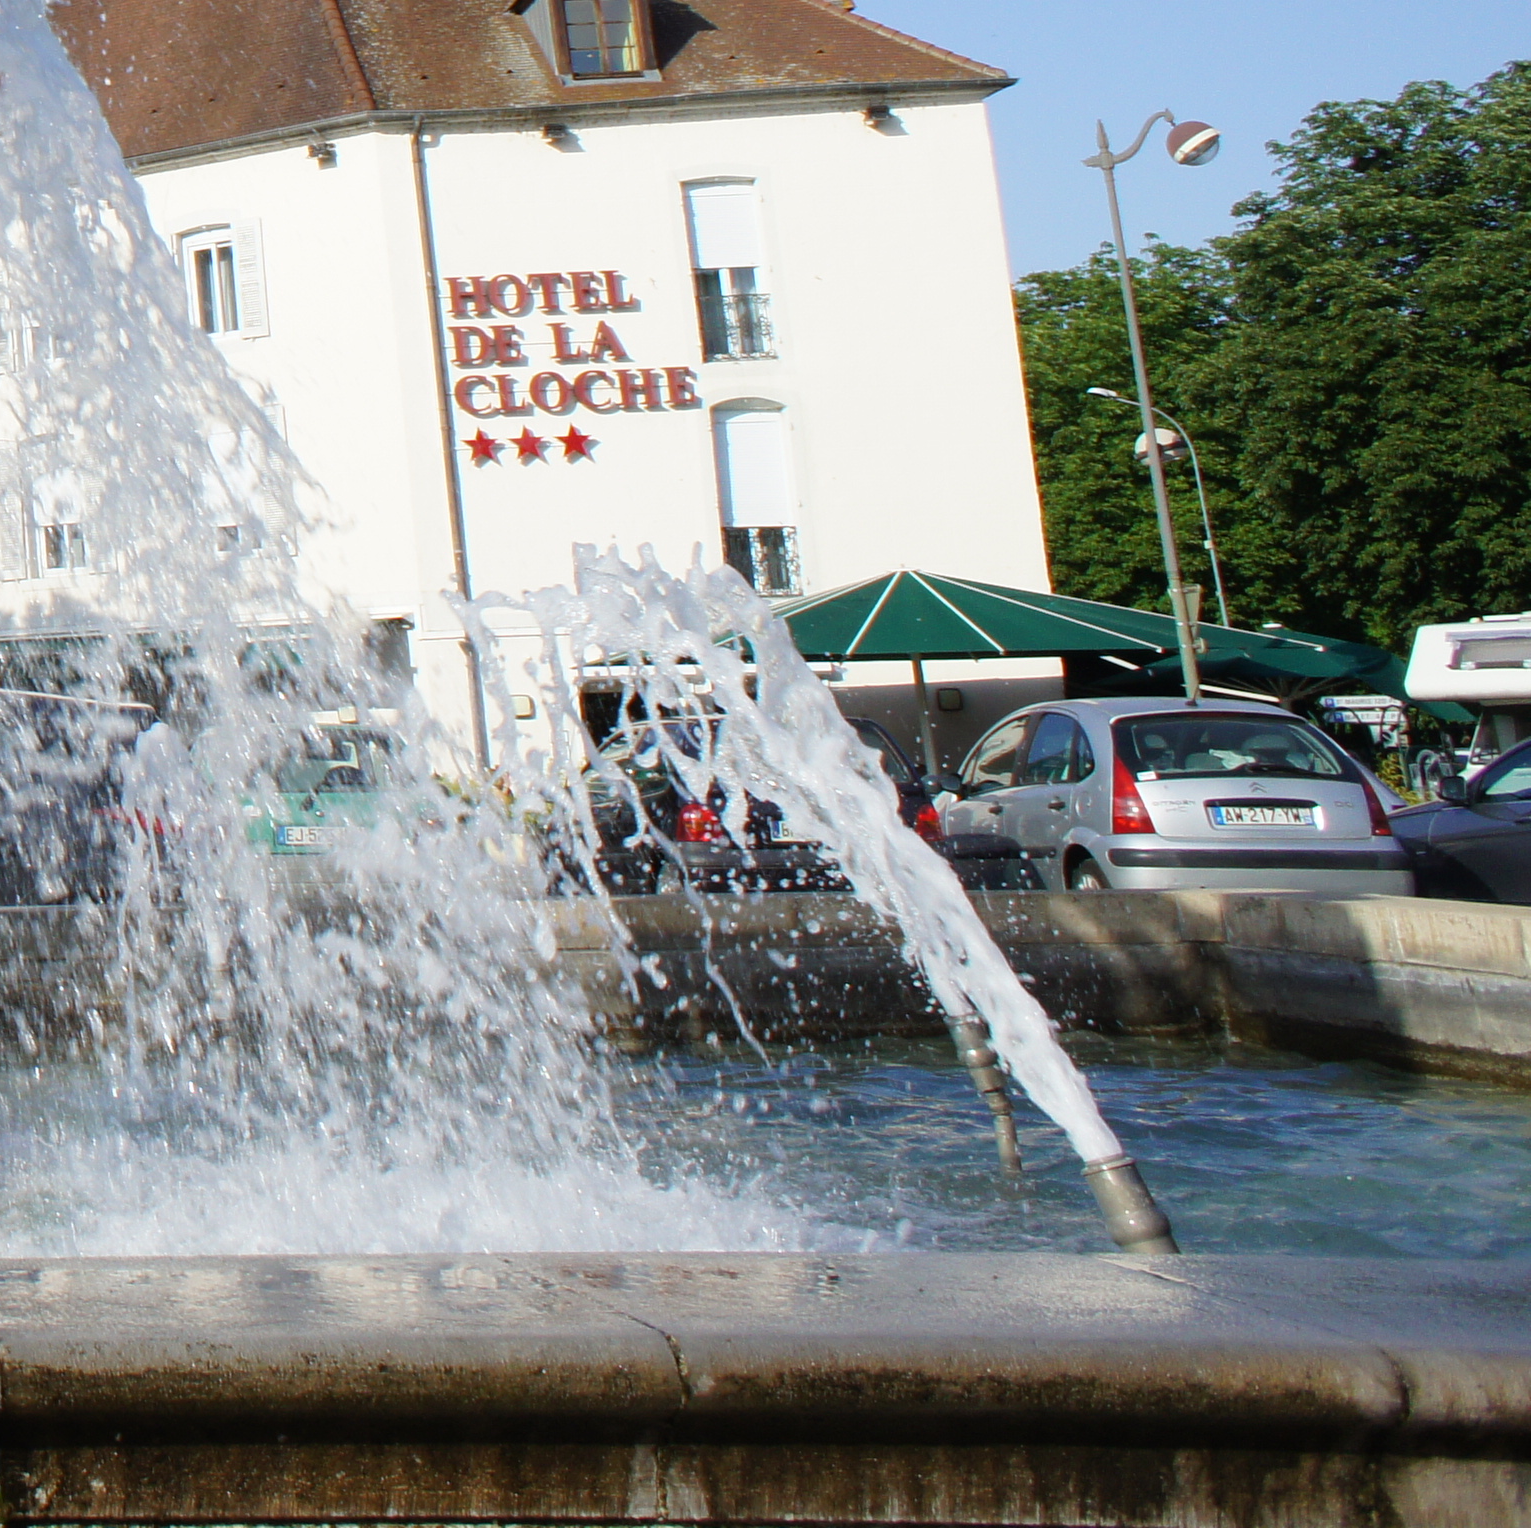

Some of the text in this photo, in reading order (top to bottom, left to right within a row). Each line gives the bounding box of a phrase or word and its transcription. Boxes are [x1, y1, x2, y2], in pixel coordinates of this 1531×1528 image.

[443, 270, 636, 315] HOTEL
[447, 320, 628, 365] DE LA
[454, 366, 699, 415] CLOCHE
